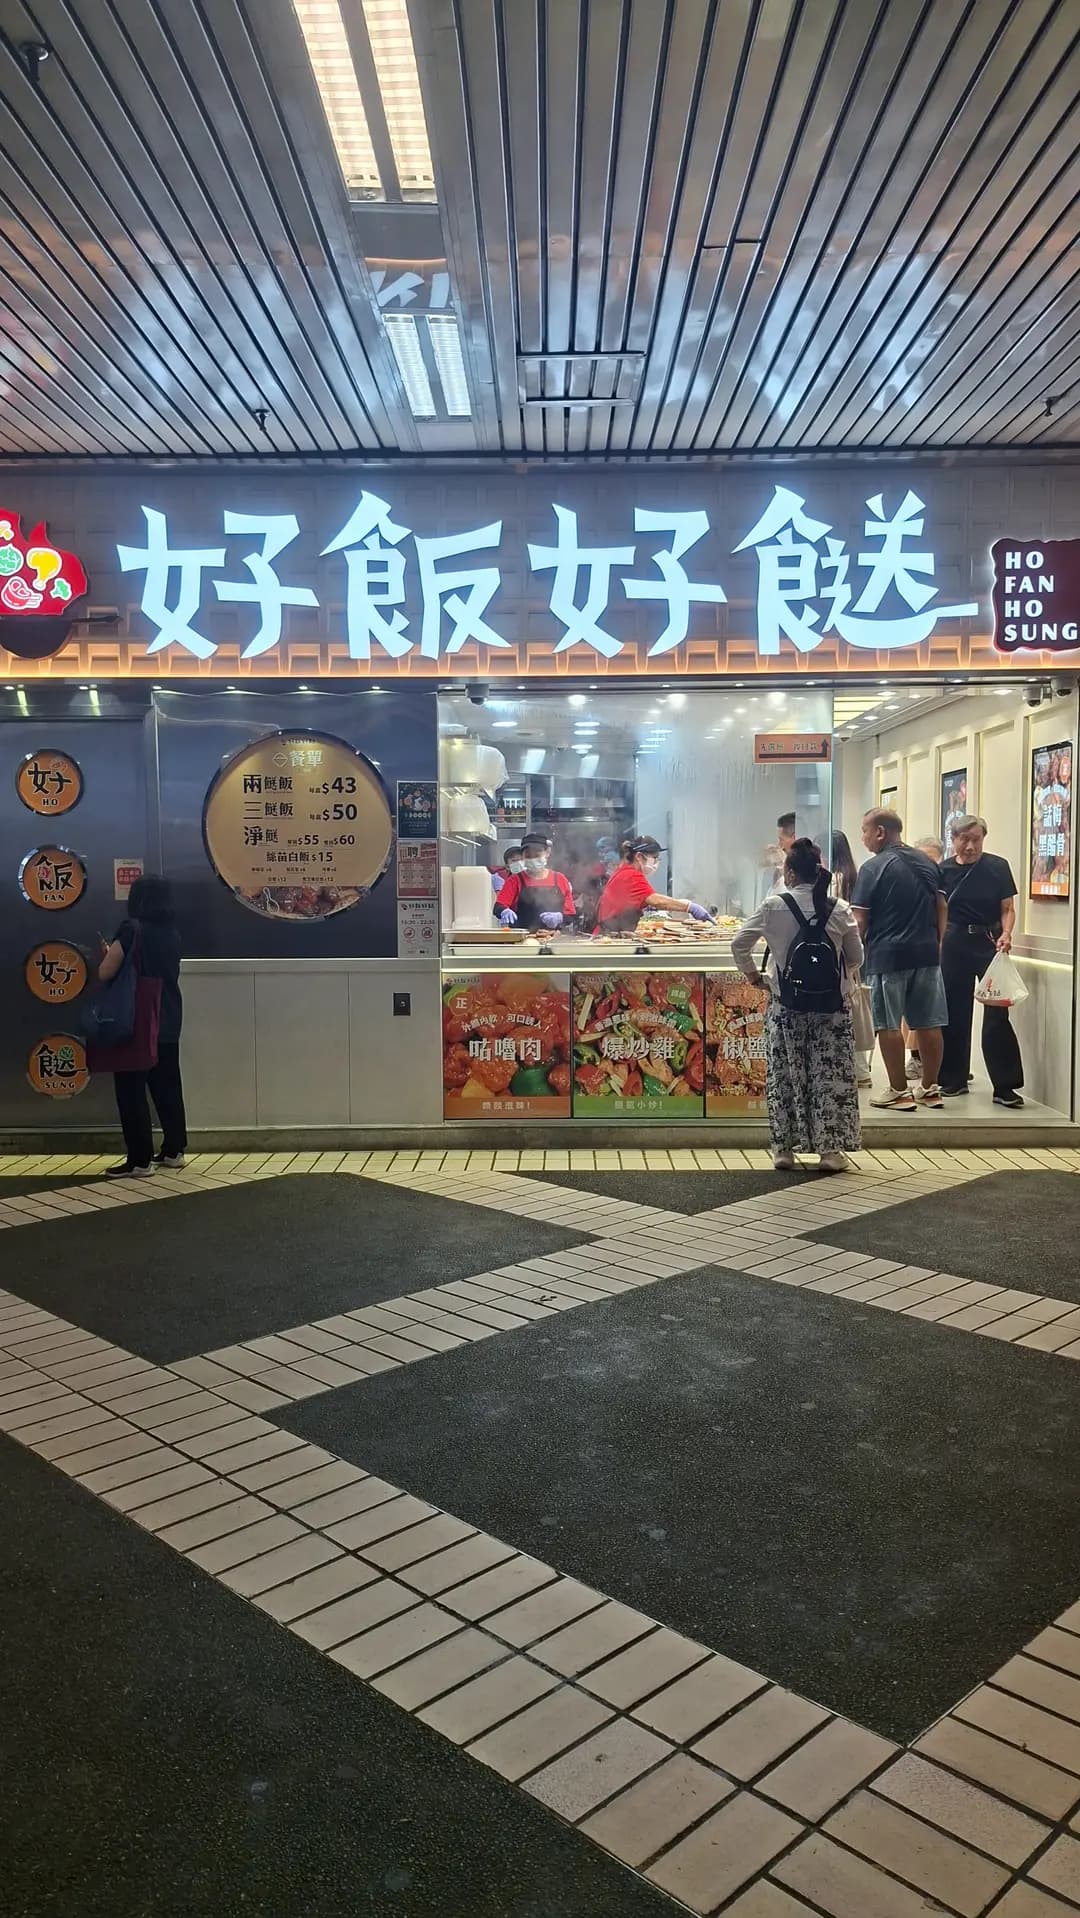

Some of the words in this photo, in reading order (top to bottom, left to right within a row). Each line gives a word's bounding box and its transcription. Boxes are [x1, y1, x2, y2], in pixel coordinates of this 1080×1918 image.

[1005, 552, 1044, 569] HO
[117, 485, 978, 661] 好飯好餸
[1005, 576, 1055, 593] FAN
[1005, 600, 1043, 618] HO
[1004, 623, 1079, 641] SUNG
[290, 750, 323, 766] 餐單
[243, 774, 293, 794] 兩餸飯
[322, 777, 357, 794] $43
[243, 801, 294, 820] 三餸飯
[322, 804, 358, 821] $50
[33, 855, 75, 891] 飯
[49, 988, 65, 996] HO
[455, 997, 468, 1009] 正
[469, 1037, 542, 1062] 咕嚕肉
[602, 1036, 675, 1061] 爆炒雞
